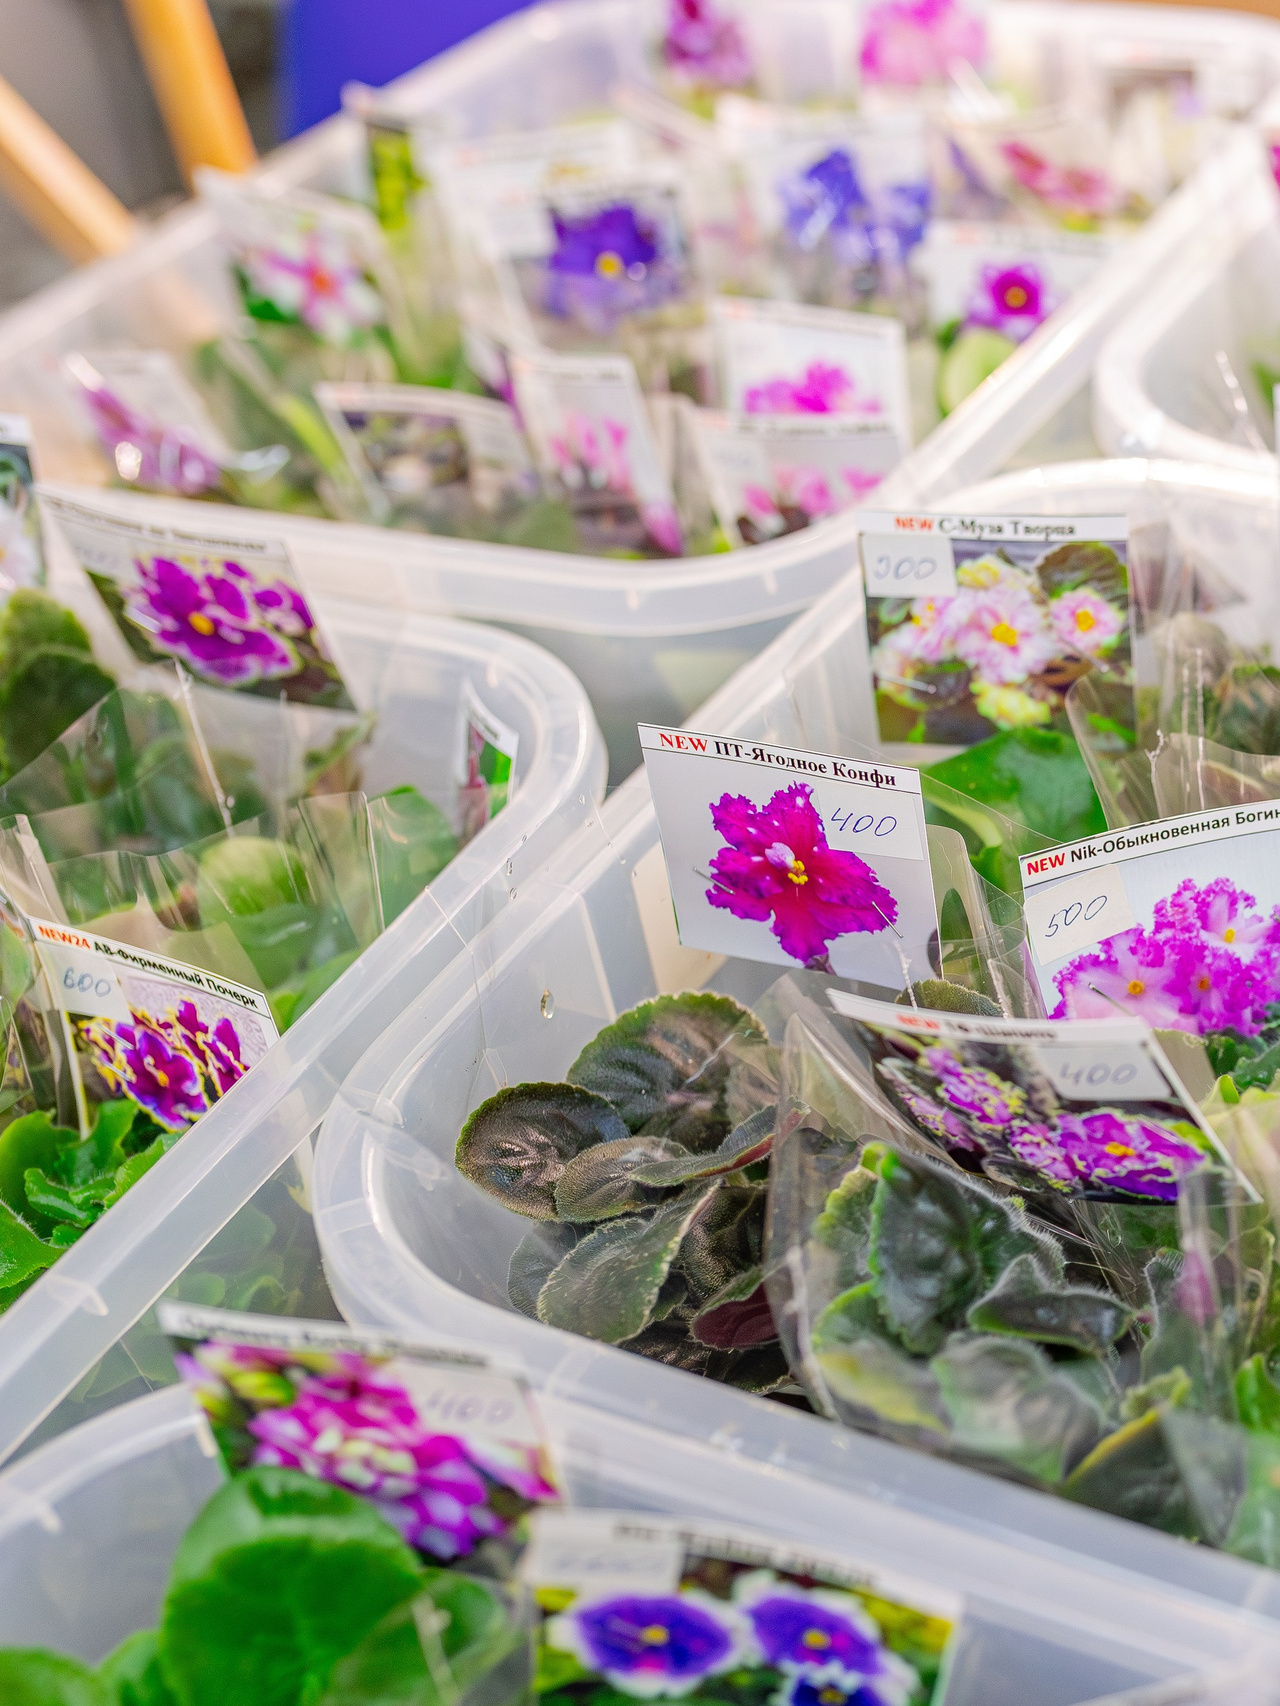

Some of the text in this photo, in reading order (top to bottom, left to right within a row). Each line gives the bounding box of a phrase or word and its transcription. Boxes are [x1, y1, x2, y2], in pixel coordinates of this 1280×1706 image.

[894, 516, 934, 531] NEW
[658, 732, 897, 789] NEW ПТ-Ягодное Конфи
[831, 807, 898, 837] 400
[1026, 852, 1066, 876] NEW
[1070, 815, 1231, 864] Nik-Обыкновенная
[1044, 895, 1108, 938] 500
[62, 966, 112, 997] 600
[206, 978, 259, 1010] Почерк
[1060, 1062, 1138, 1087] 400
